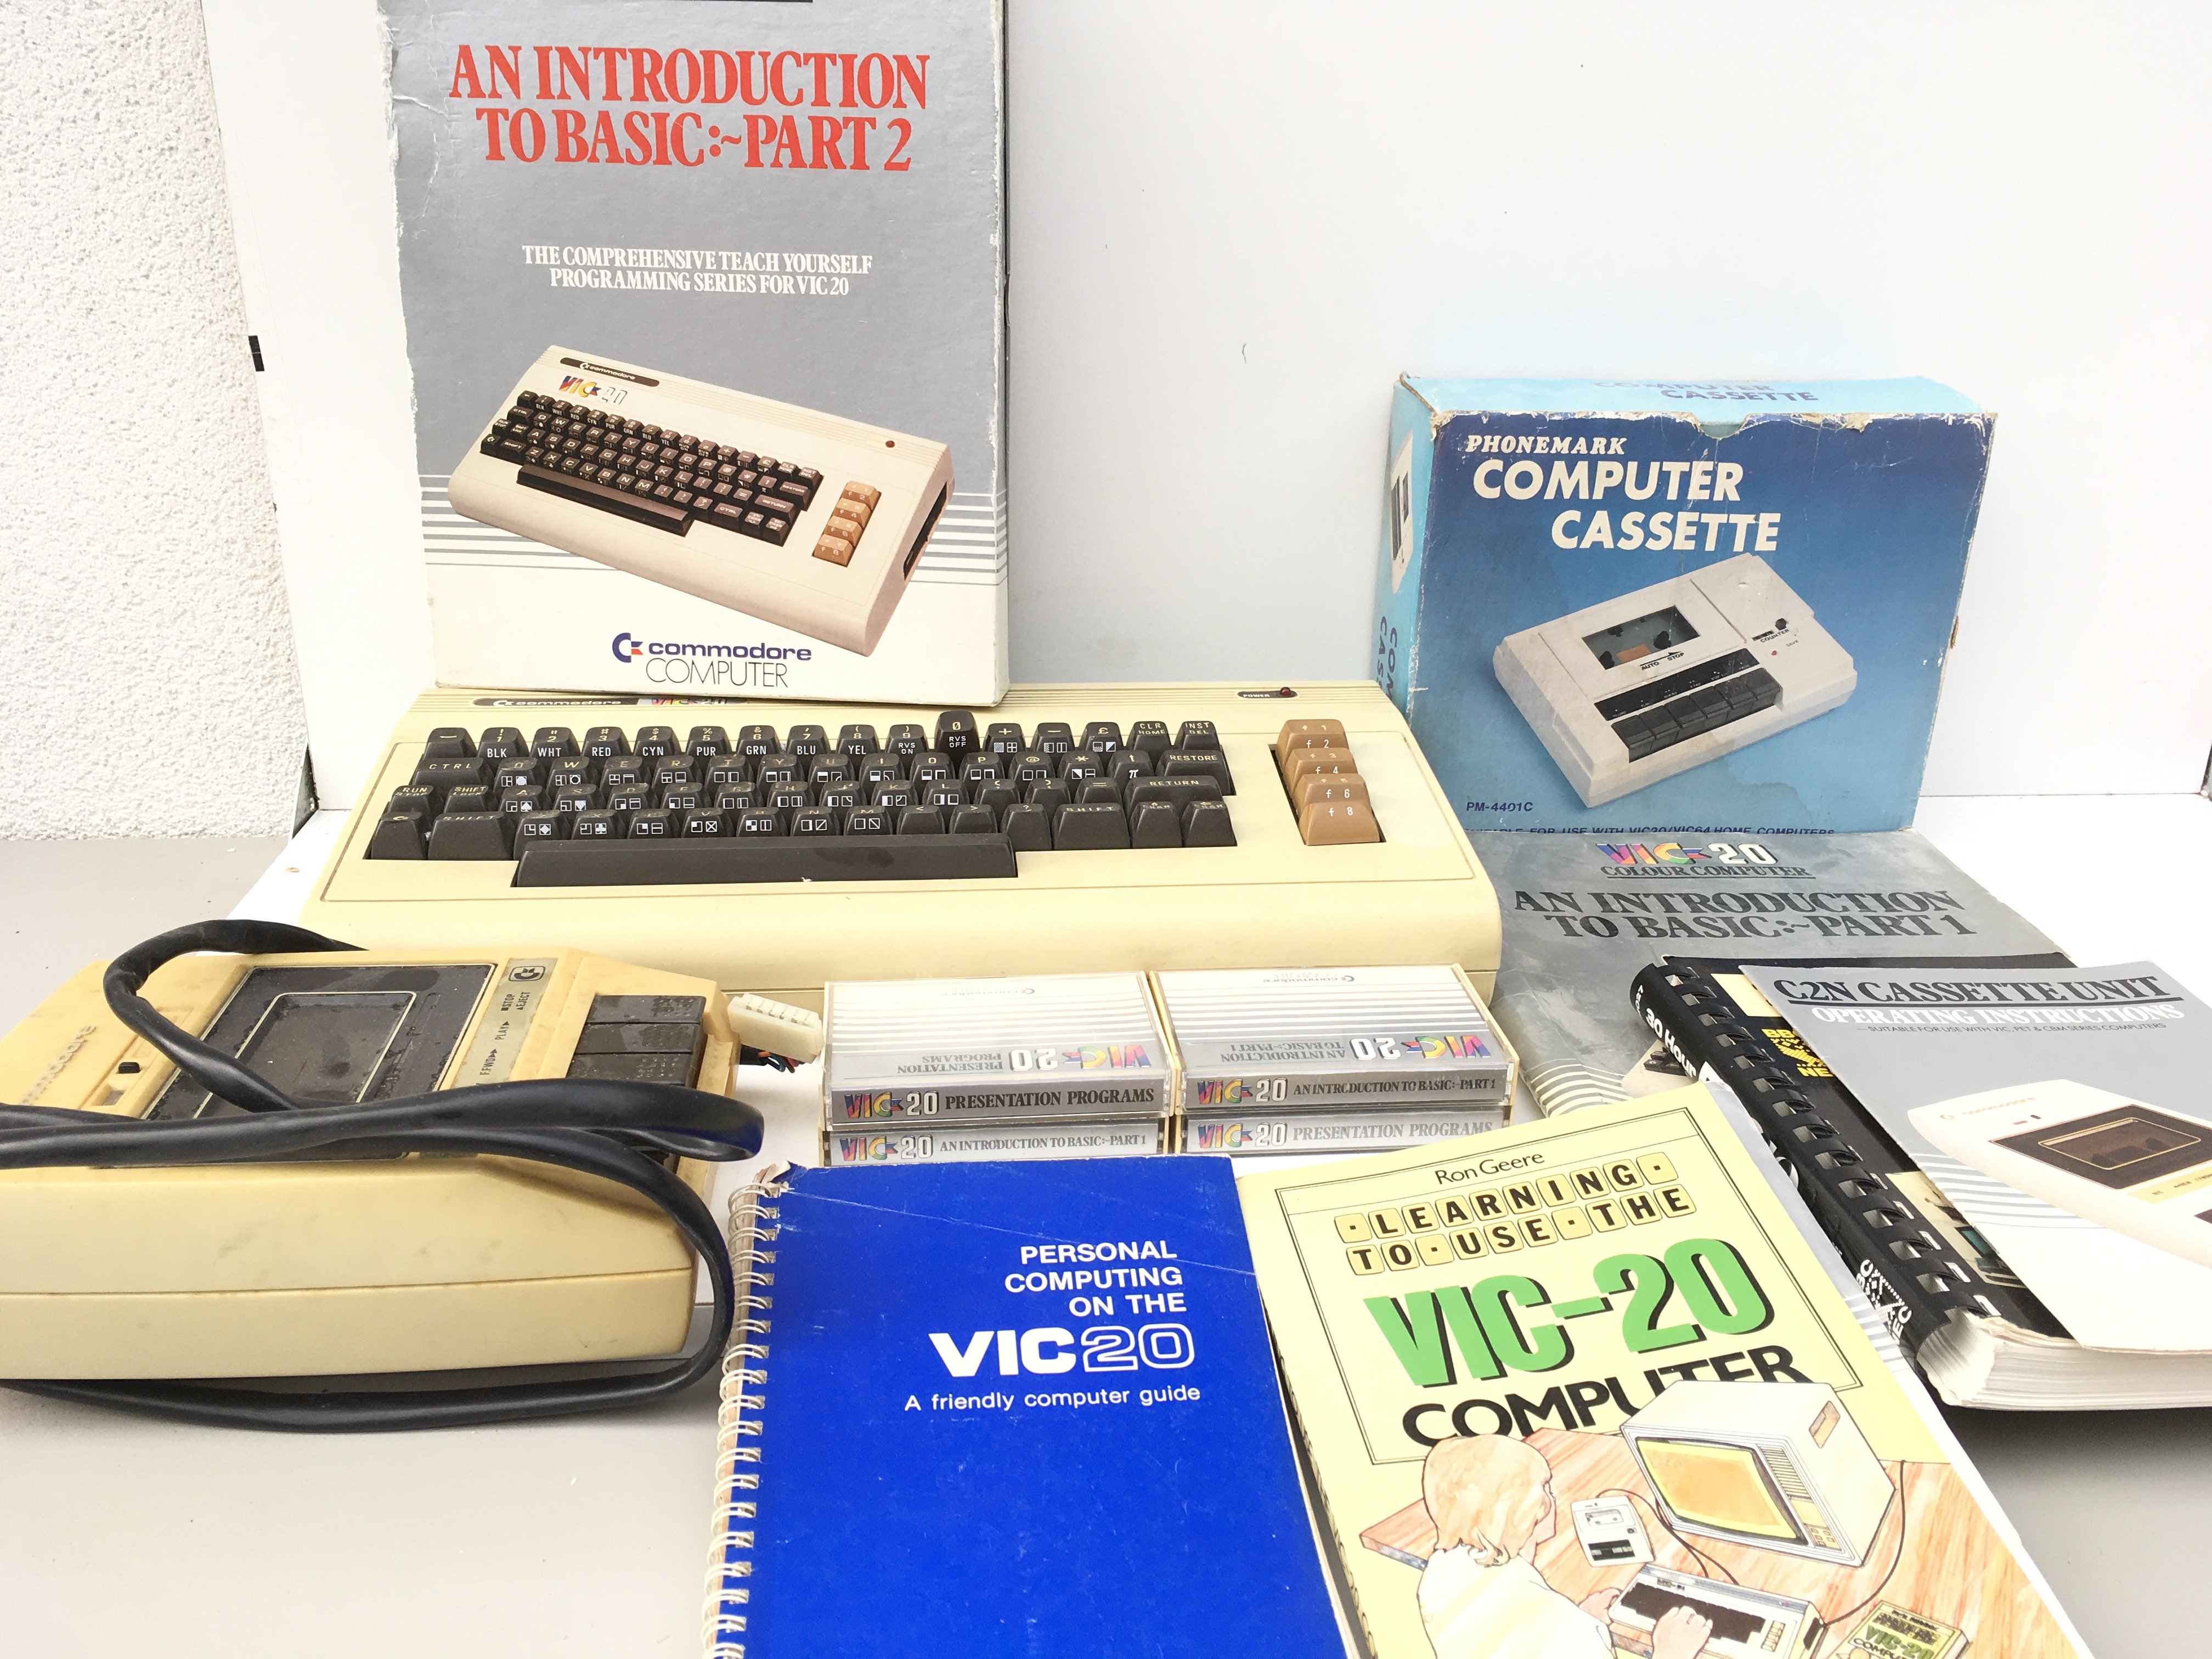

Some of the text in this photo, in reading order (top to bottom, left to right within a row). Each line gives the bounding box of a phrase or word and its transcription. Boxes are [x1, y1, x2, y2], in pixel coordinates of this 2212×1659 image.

[449, 45, 929, 109] AN INTRODUCTION
[476, 108, 547, 162] TO
[884, 119, 912, 171] 2
[522, 245, 872, 275] THE COMPREHENSIVE TEACH YOURSELF
[550, 268, 849, 296] PROGRAMMING SERIES FOR VIC 20
[587, 365, 636, 381] commodore
[1594, 382, 1775, 391] COMPUTER
[1660, 390, 1819, 402] CASSETTE
[1465, 435, 1627, 455] PHONEMARK
[1473, 459, 1743, 502] COMPUTER
[1551, 511, 1781, 552] CASSETTE
[1760, 629, 1789, 643] COUNTER
[649, 642, 811, 662] commodore
[1641, 652, 1685, 670] AUTO STOP
[646, 658, 788, 688] COMPUTER
[487, 748, 507, 758] BLK
[538, 747, 562, 757] WHT
[592, 747, 611, 757] RED
[642, 746, 664, 756] CYN
[697, 746, 716, 756] PUR
[746, 746, 767, 755] GRN
[797, 745, 816, 755] BLU
[848, 745, 866, 755] YEL
[1466, 802, 1533, 812] PM-4401C
[1601, 866, 1813, 877] COLOUR COMPUTER
[1515, 891, 1965, 913] AN INTRODUCTION
[1544, 915, 1618, 938] TO
[1940, 914, 1977, 934] 1
[1773, 975, 2172, 1003] C2N CASSETTE UNIT
[503, 994, 515, 1011] STOP
[518, 991, 531, 1008] EJECT
[1812, 1004, 2185, 1025] OPERATING INSTRUCTIONS
[495, 1024, 510, 1040] PLAY
[1646, 1008, 1697, 1078] 30 Hour
[922, 1053, 1002, 1063] PROGRAMS
[1221, 1051, 1324, 1062] INTRODUCTION
[897, 1062, 1003, 1074] PRESENTATION
[1294, 1084, 1311, 1095] AN
[1312, 1081, 1400, 1095] INTRODUCTION
[1401, 1081, 1417, 1091] TO
[1491, 1079, 1496, 1088] 1
[945, 1091, 1061, 1109] PRESENTATION
[1068, 1088, 1154, 1105] PROGRAMS
[1293, 1124, 1403, 1141] PRESENTATION
[1408, 1121, 1492, 1137] PROGRAMS
[940, 1141, 957, 1152] AN
[958, 1137, 1048, 1152] INTRODUCTION
[1050, 1137, 1066, 1147] TO
[1141, 1135, 1146, 1145] 1
[1435, 1150, 1545, 1186] Ron Geere
[1591, 1187, 1690, 1226] THE
[1020, 1240, 1176, 1265] PERSONAL
[1005, 1267, 1183, 1293] COMPUTING
[1069, 1292, 1187, 1318] ON THE
[1364, 1238, 1776, 1388] VIC-20
[904, 1384, 1201, 1412] A friendly computer guide
